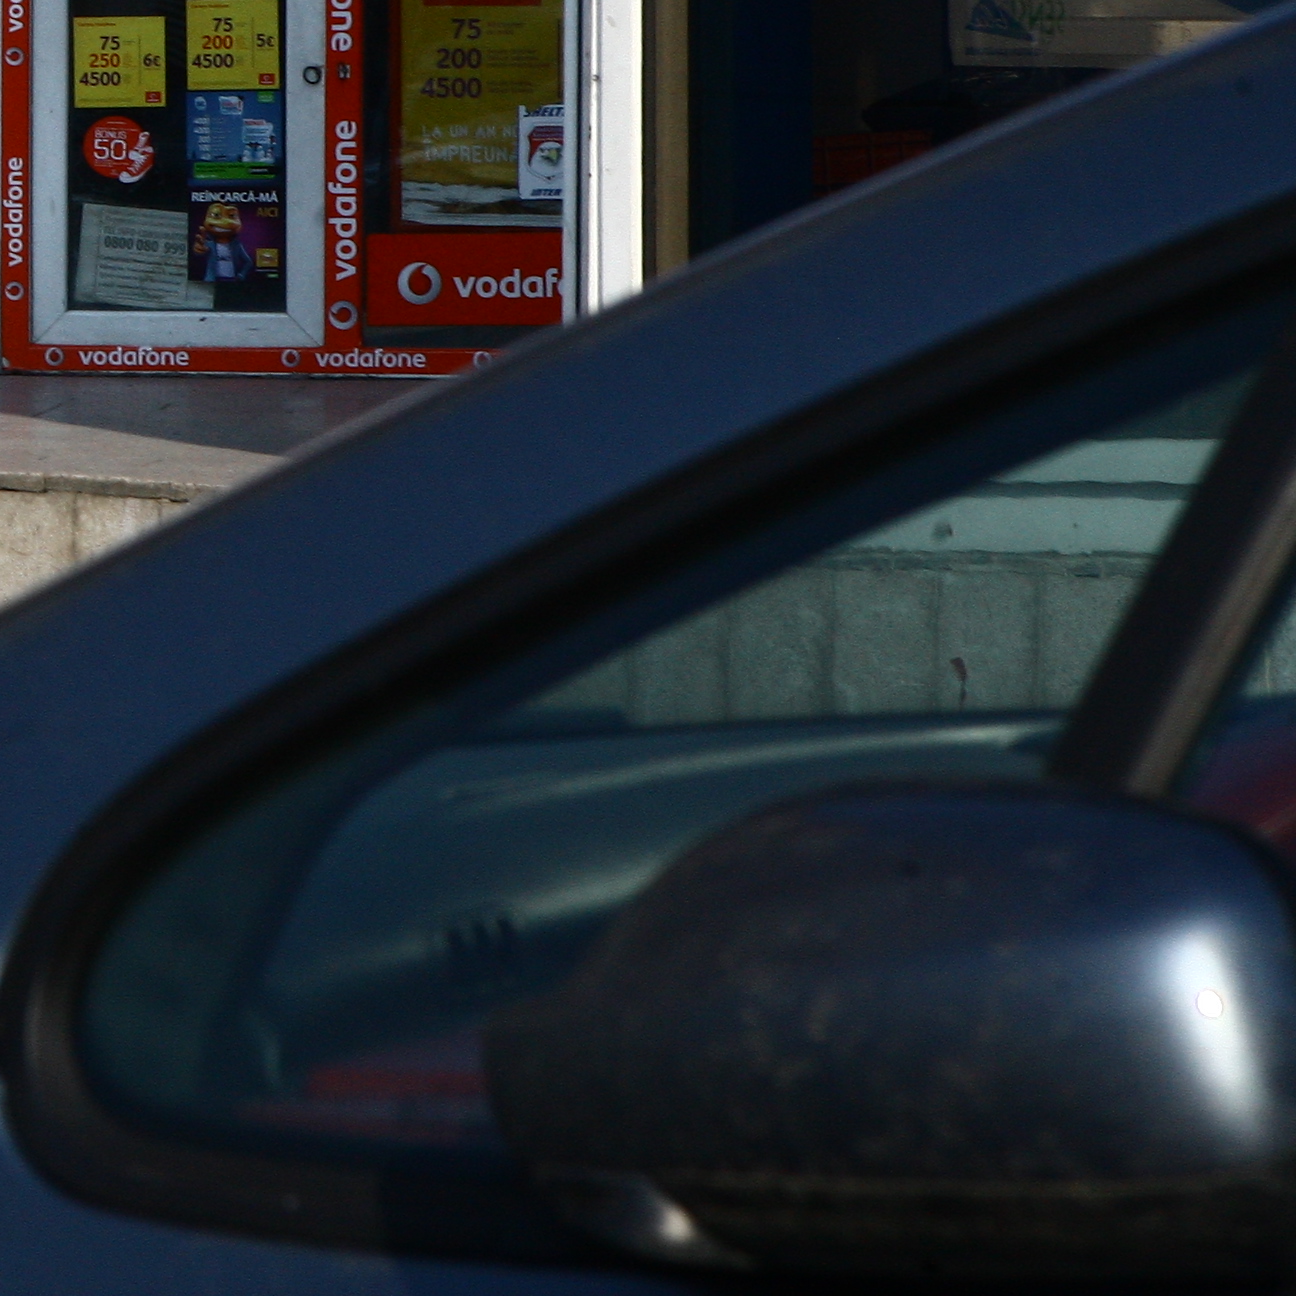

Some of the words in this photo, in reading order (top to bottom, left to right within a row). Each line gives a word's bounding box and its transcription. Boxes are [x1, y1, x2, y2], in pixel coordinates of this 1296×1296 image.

[212, 17, 233, 32] 75
[451, 18, 482, 39] 75
[99, 36, 121, 51] 75
[201, 35, 234, 50] 200
[89, 52, 121, 69] 250
[192, 53, 235, 68] 4500
[436, 47, 483, 70] 200
[79, 71, 121, 87] 4500
[420, 77, 483, 99] 4500
[94, 130, 128, 139] BONUS
[93, 138, 128, 161] 50
[329, 119, 359, 282] vodafone
[3, 156, 24, 268] vodafone
[78, 347, 190, 368] vodafone
[315, 348, 426, 369] vodafone
